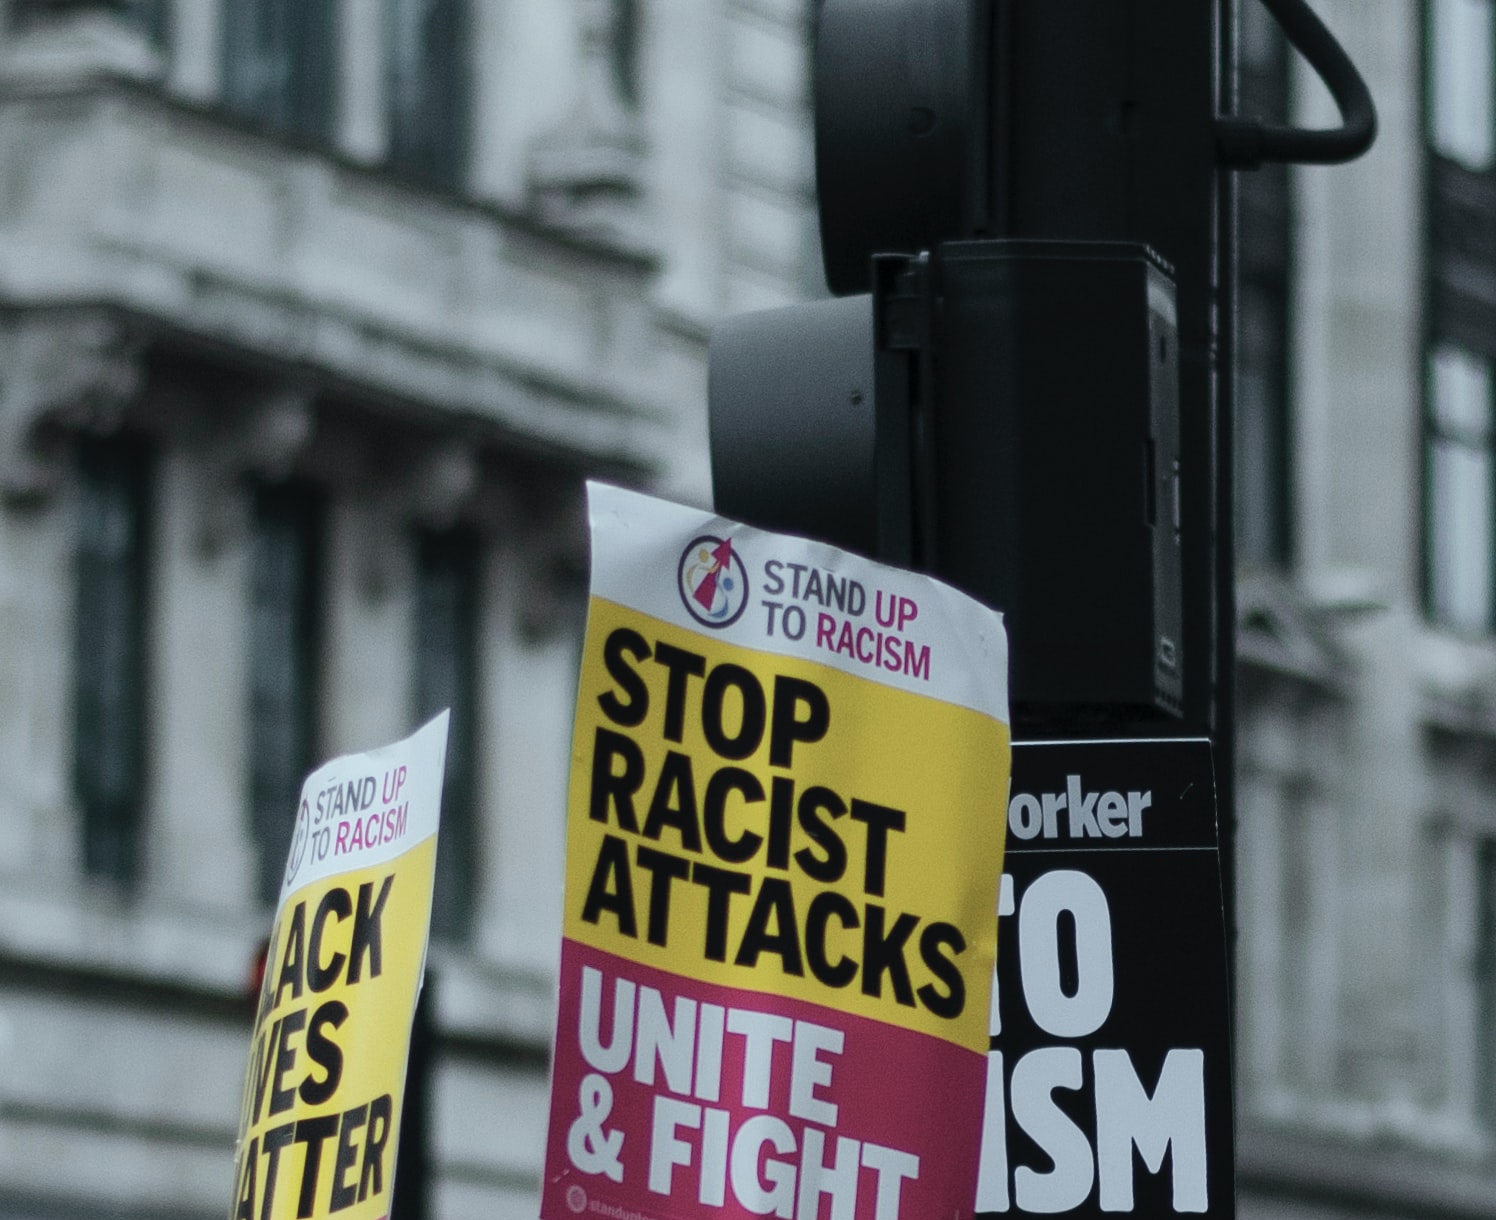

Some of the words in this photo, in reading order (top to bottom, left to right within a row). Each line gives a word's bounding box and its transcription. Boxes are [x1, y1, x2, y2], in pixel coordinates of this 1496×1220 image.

[761, 600, 806, 641] TO
[816, 613, 931, 681] RACISM
[762, 559, 866, 616] STAND
[875, 591, 918, 632] UP
[597, 627, 831, 769] STOP
[310, 826, 331, 865] TO
[333, 801, 409, 856] RACISM
[314, 775, 377, 826] STAND
[382, 765, 408, 805] UP
[588, 727, 906, 898] RACIST
[1006, 775, 1152, 840] orker
[580, 834, 967, 1019] ATTACKS
[989, 869, 1114, 1038] O
[579, 966, 845, 1127] UNITE
[566, 1073, 625, 1183] &
[974, 1046, 1209, 1214] ISM
